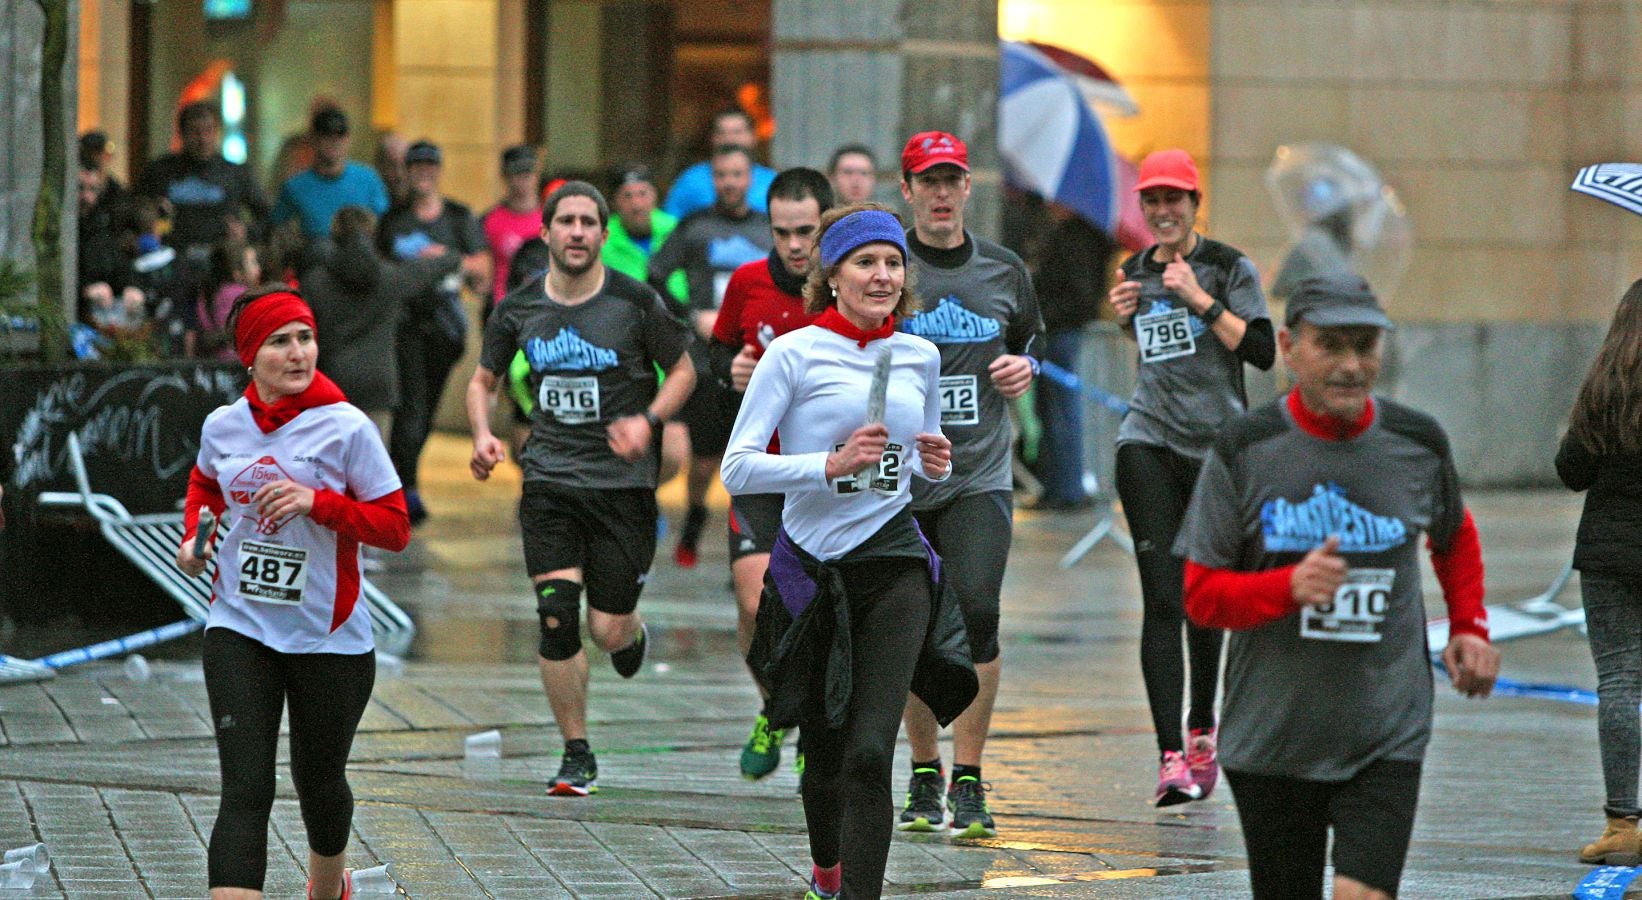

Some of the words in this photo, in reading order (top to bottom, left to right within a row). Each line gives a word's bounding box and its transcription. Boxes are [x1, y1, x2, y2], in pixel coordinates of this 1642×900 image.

[1144, 322, 1188, 346] 796
[547, 390, 594, 408] 816
[943, 389, 973, 409] 12
[241, 555, 302, 586] 487
